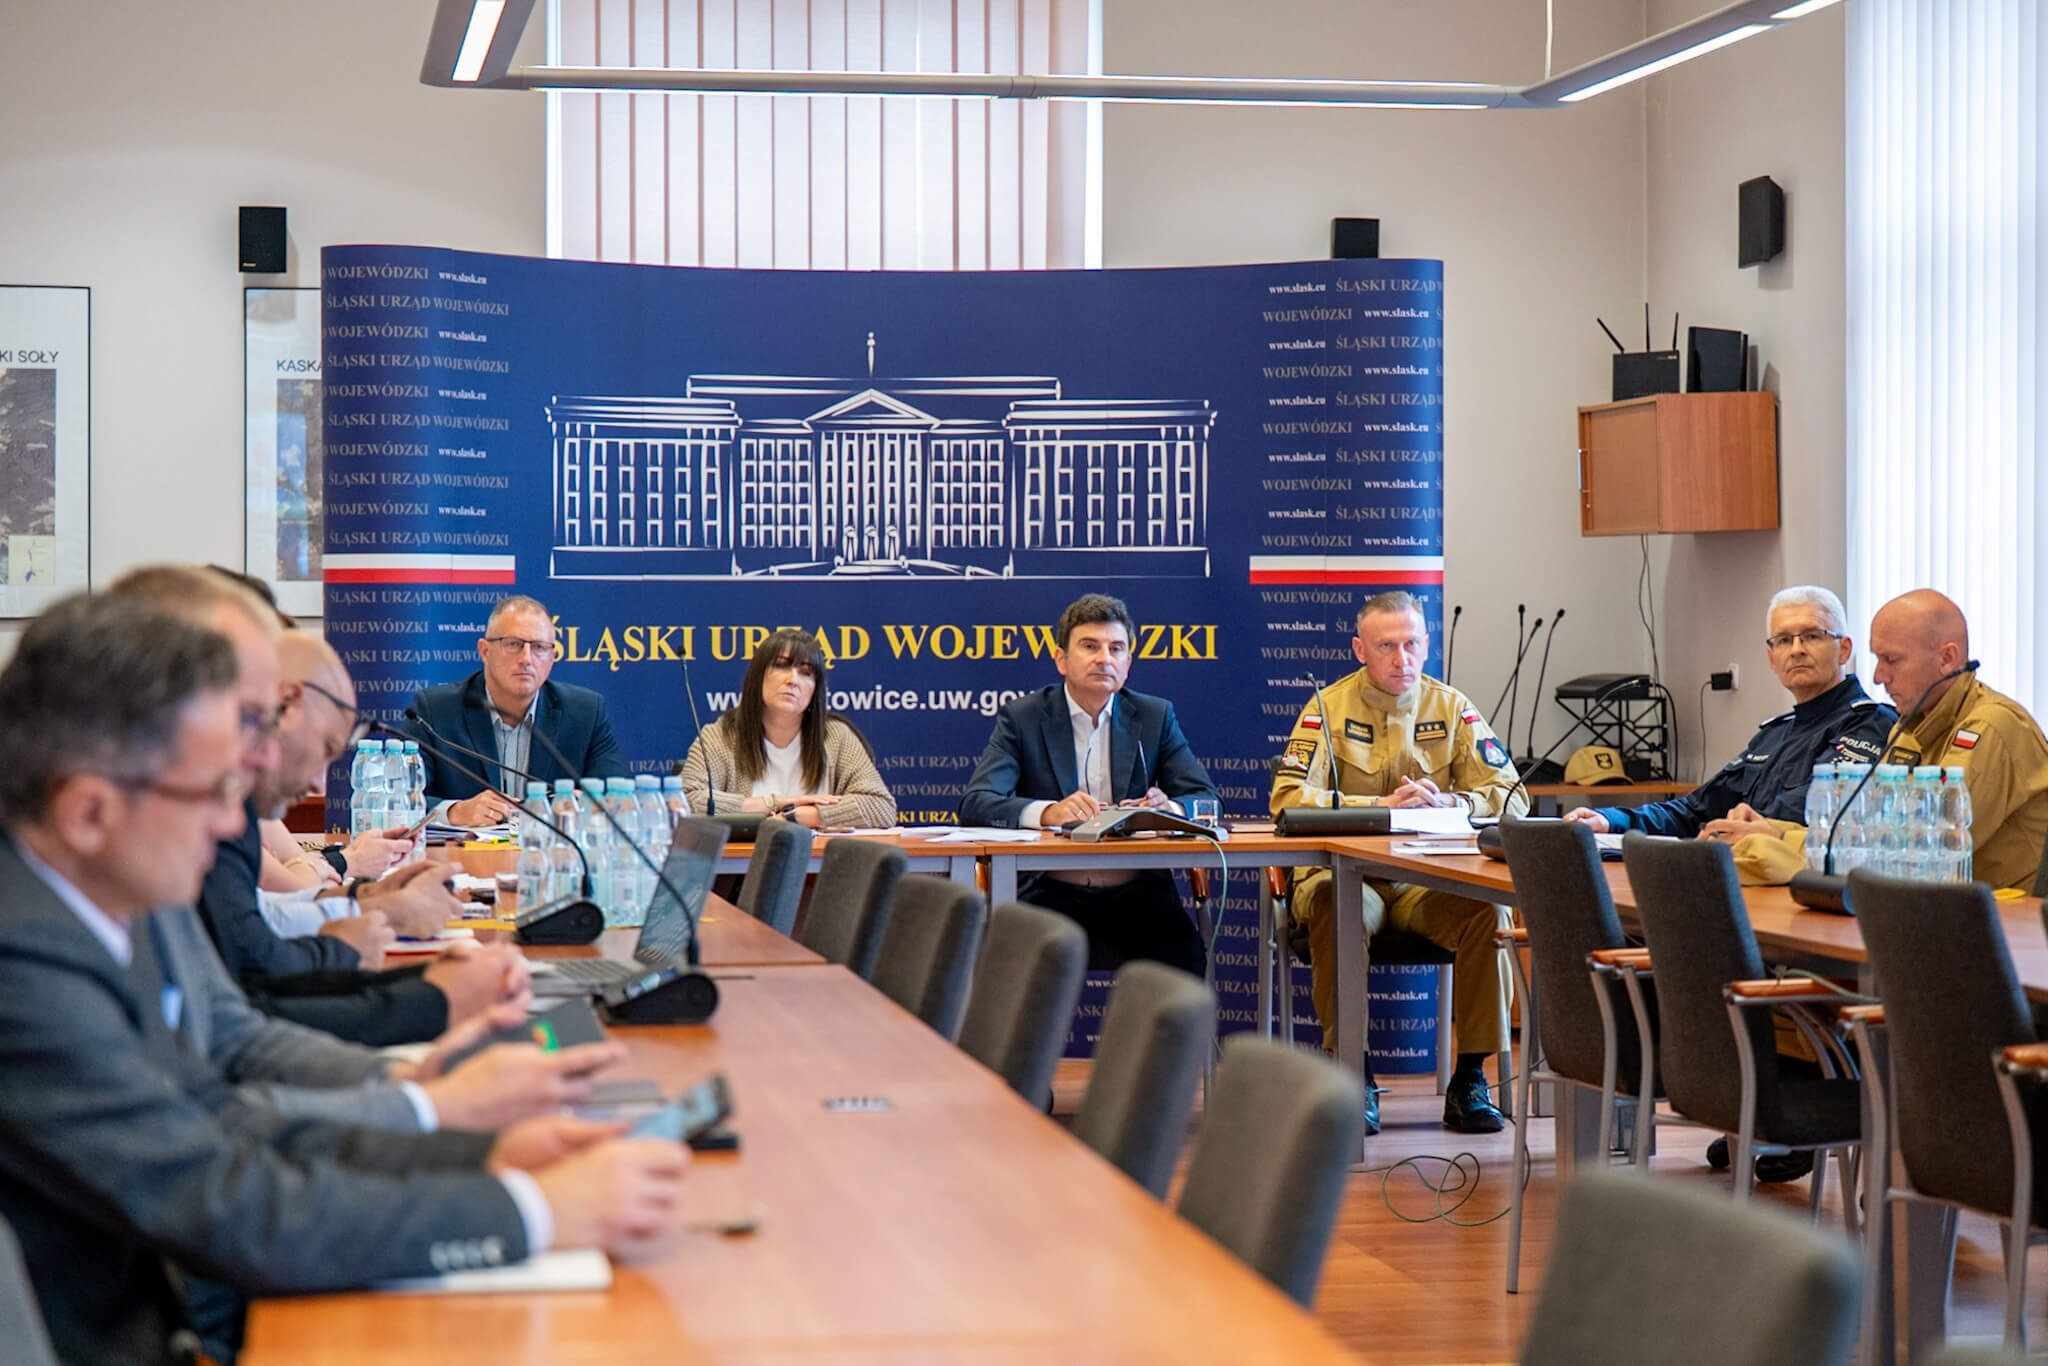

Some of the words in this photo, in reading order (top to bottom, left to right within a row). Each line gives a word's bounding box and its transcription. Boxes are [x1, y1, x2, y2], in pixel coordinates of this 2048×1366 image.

[327, 263, 429, 280] WOJEWÓDZKI
[381, 295, 430, 311] URZĄD
[1262, 306, 1352, 323] WOJEWÓDZKI
[327, 322, 429, 339] WOJEWÓDZKI
[18, 350, 58, 363] SOŁY
[381, 354, 430, 370] URZĄD
[1262, 362, 1352, 379] WOJEWÓDZKI
[328, 381, 429, 397] WOJEWÓDZKI
[381, 413, 430, 429] URZĄD
[1262, 418, 1352, 435] WOJEWÓDZKI
[329, 440, 429, 456] WOJEWÓDZKI
[381, 472, 430, 488] URZĄD
[1262, 476, 1352, 492] WOJEWÓDZKI
[329, 499, 429, 516] WOJEWÓDZKI
[381, 531, 430, 547] URZĄD
[1262, 532, 1352, 548] WOJEWÓDZKI
[382, 590, 430, 604] URZĄD
[1261, 588, 1352, 604] WOJEWÓDZKI
[331, 617, 429, 633] WOJEWÓDZKI
[883, 624, 1219, 660] WOJEWZKI
[382, 649, 430, 664] URZĄD
[920, 810, 959, 825] URZĄ
